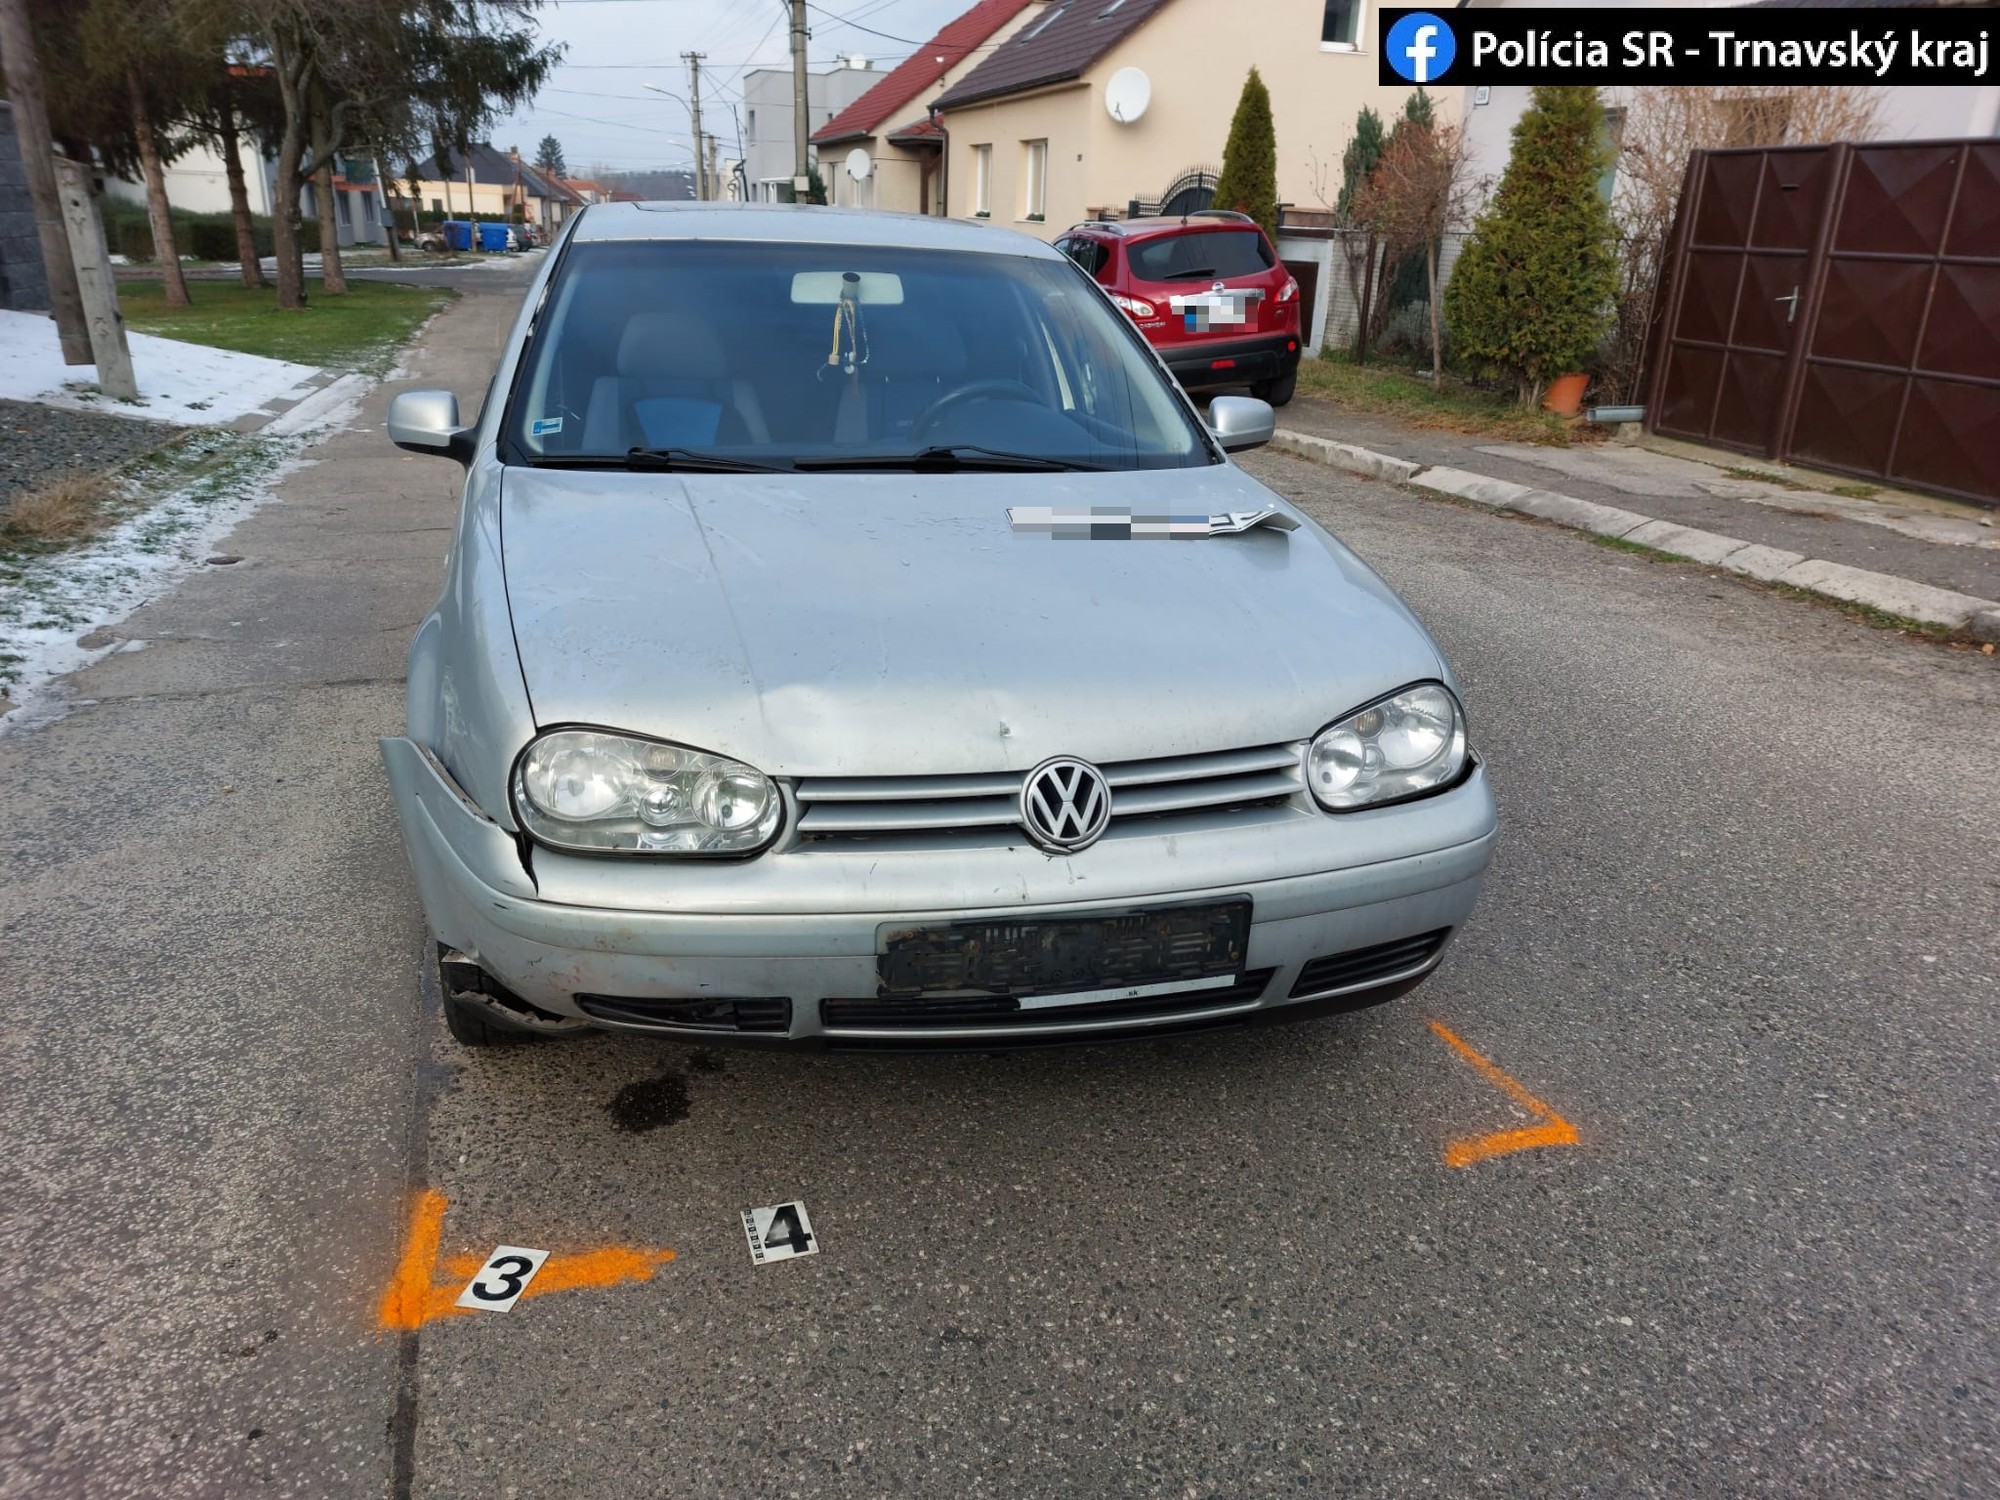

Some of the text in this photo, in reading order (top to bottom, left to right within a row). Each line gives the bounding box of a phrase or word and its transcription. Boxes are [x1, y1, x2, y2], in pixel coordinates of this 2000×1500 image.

[1026, 761, 1107, 842] VW
[764, 1204, 813, 1254] 4
[472, 1255, 534, 1301] 3
